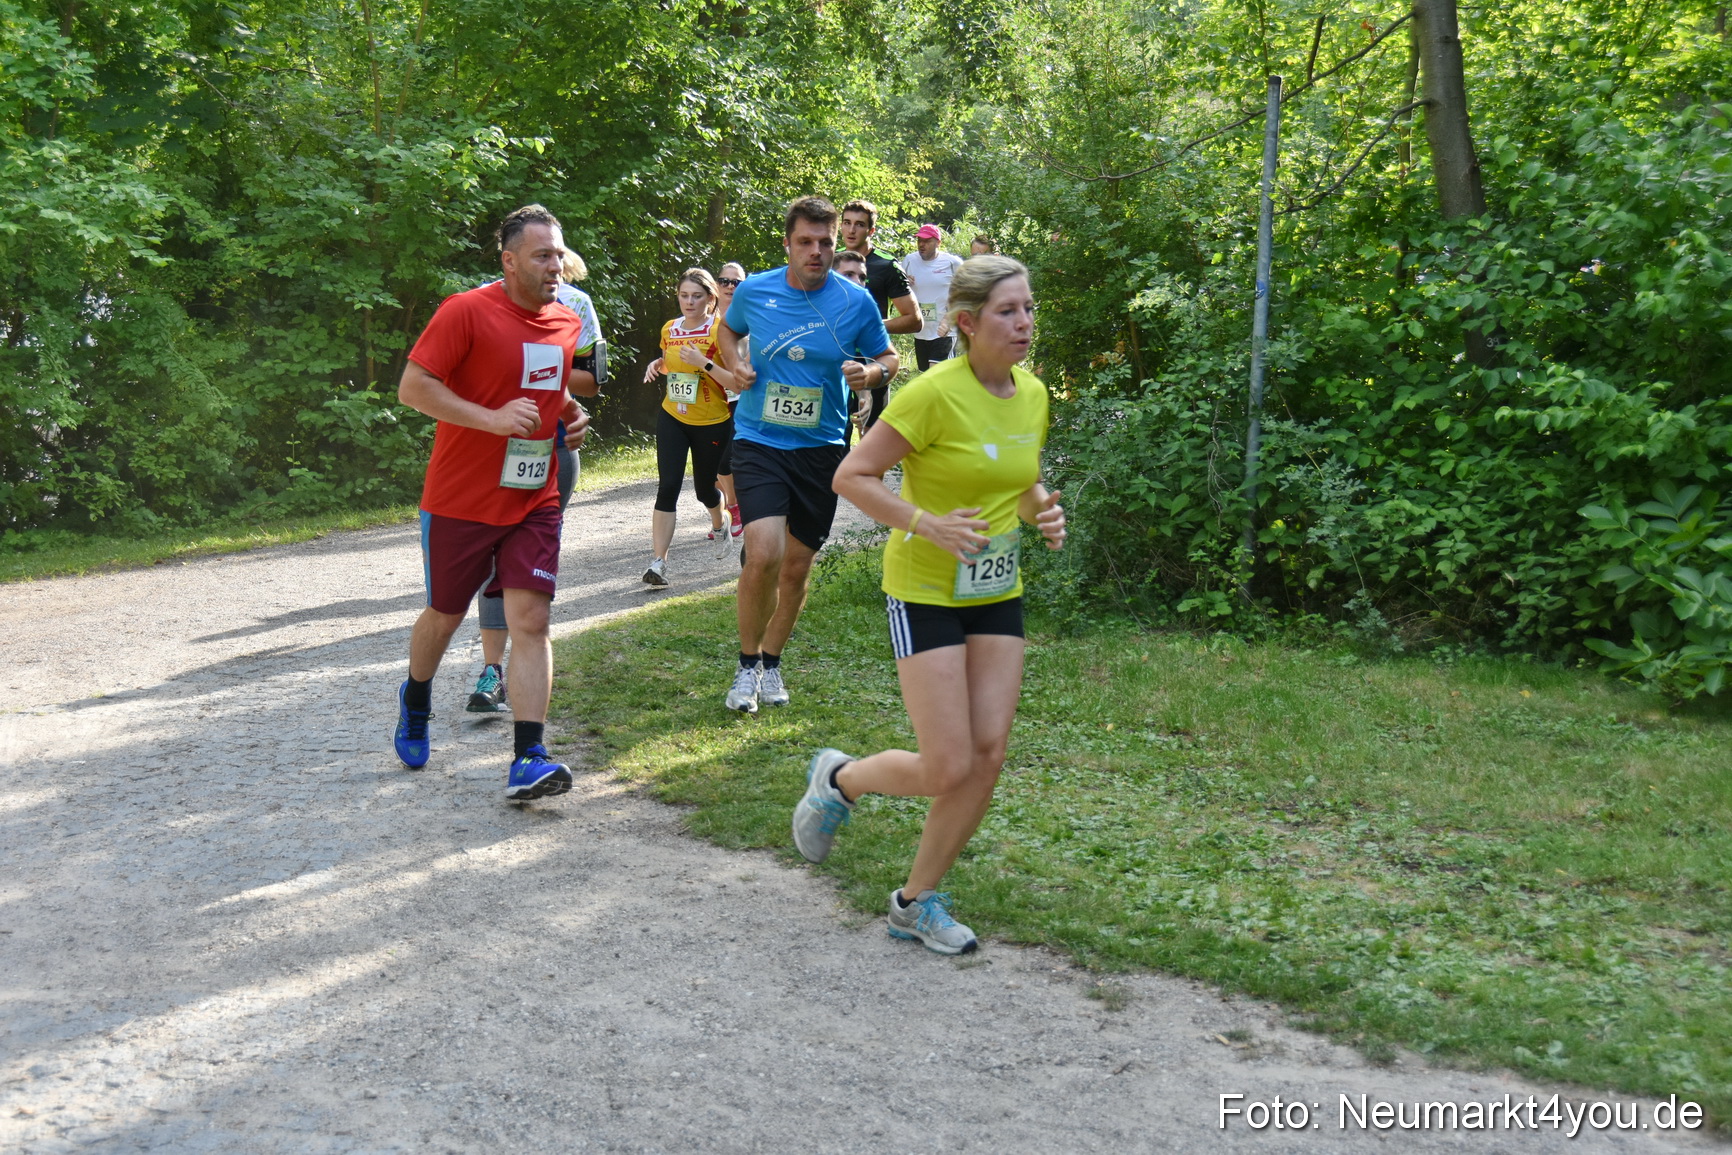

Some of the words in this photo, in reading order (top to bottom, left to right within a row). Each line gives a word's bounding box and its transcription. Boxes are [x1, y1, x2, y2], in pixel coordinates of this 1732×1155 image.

[760, 339, 778, 356] Team
[779, 325, 806, 340] Schick
[670, 383, 692, 395] 1615
[772, 397, 814, 417] 1534
[517, 461, 546, 478] 9129
[967, 552, 1014, 581] 1285
